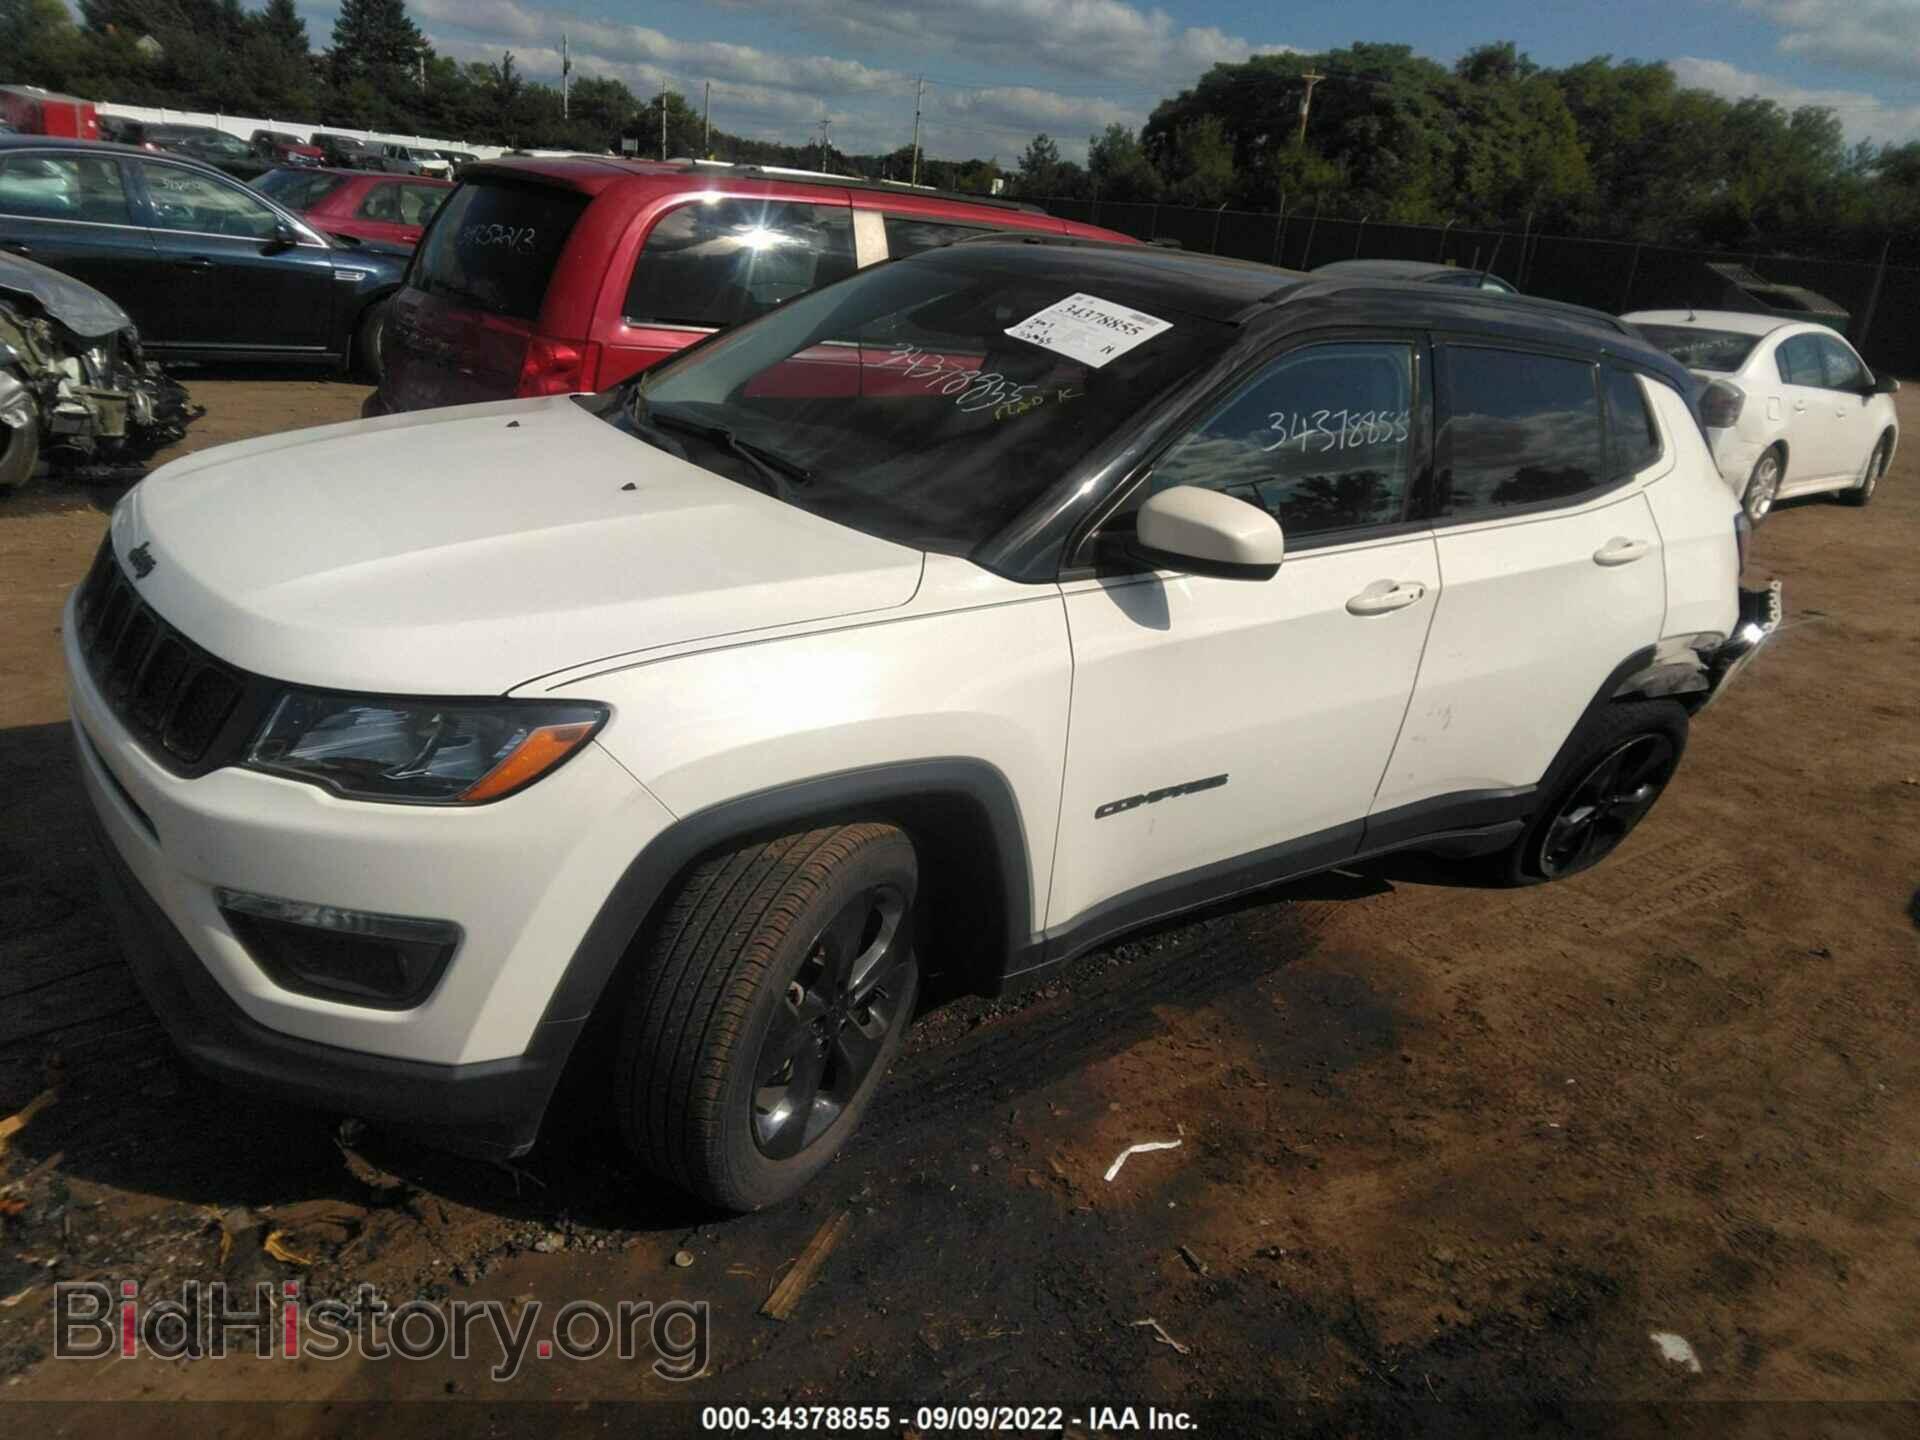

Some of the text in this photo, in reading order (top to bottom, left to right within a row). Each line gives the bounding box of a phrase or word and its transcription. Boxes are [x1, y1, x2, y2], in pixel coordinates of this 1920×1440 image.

[1059, 304, 1145, 337] 34378855
[883, 342, 1038, 413] 34378855
[1262, 408, 1411, 453] 34378855
